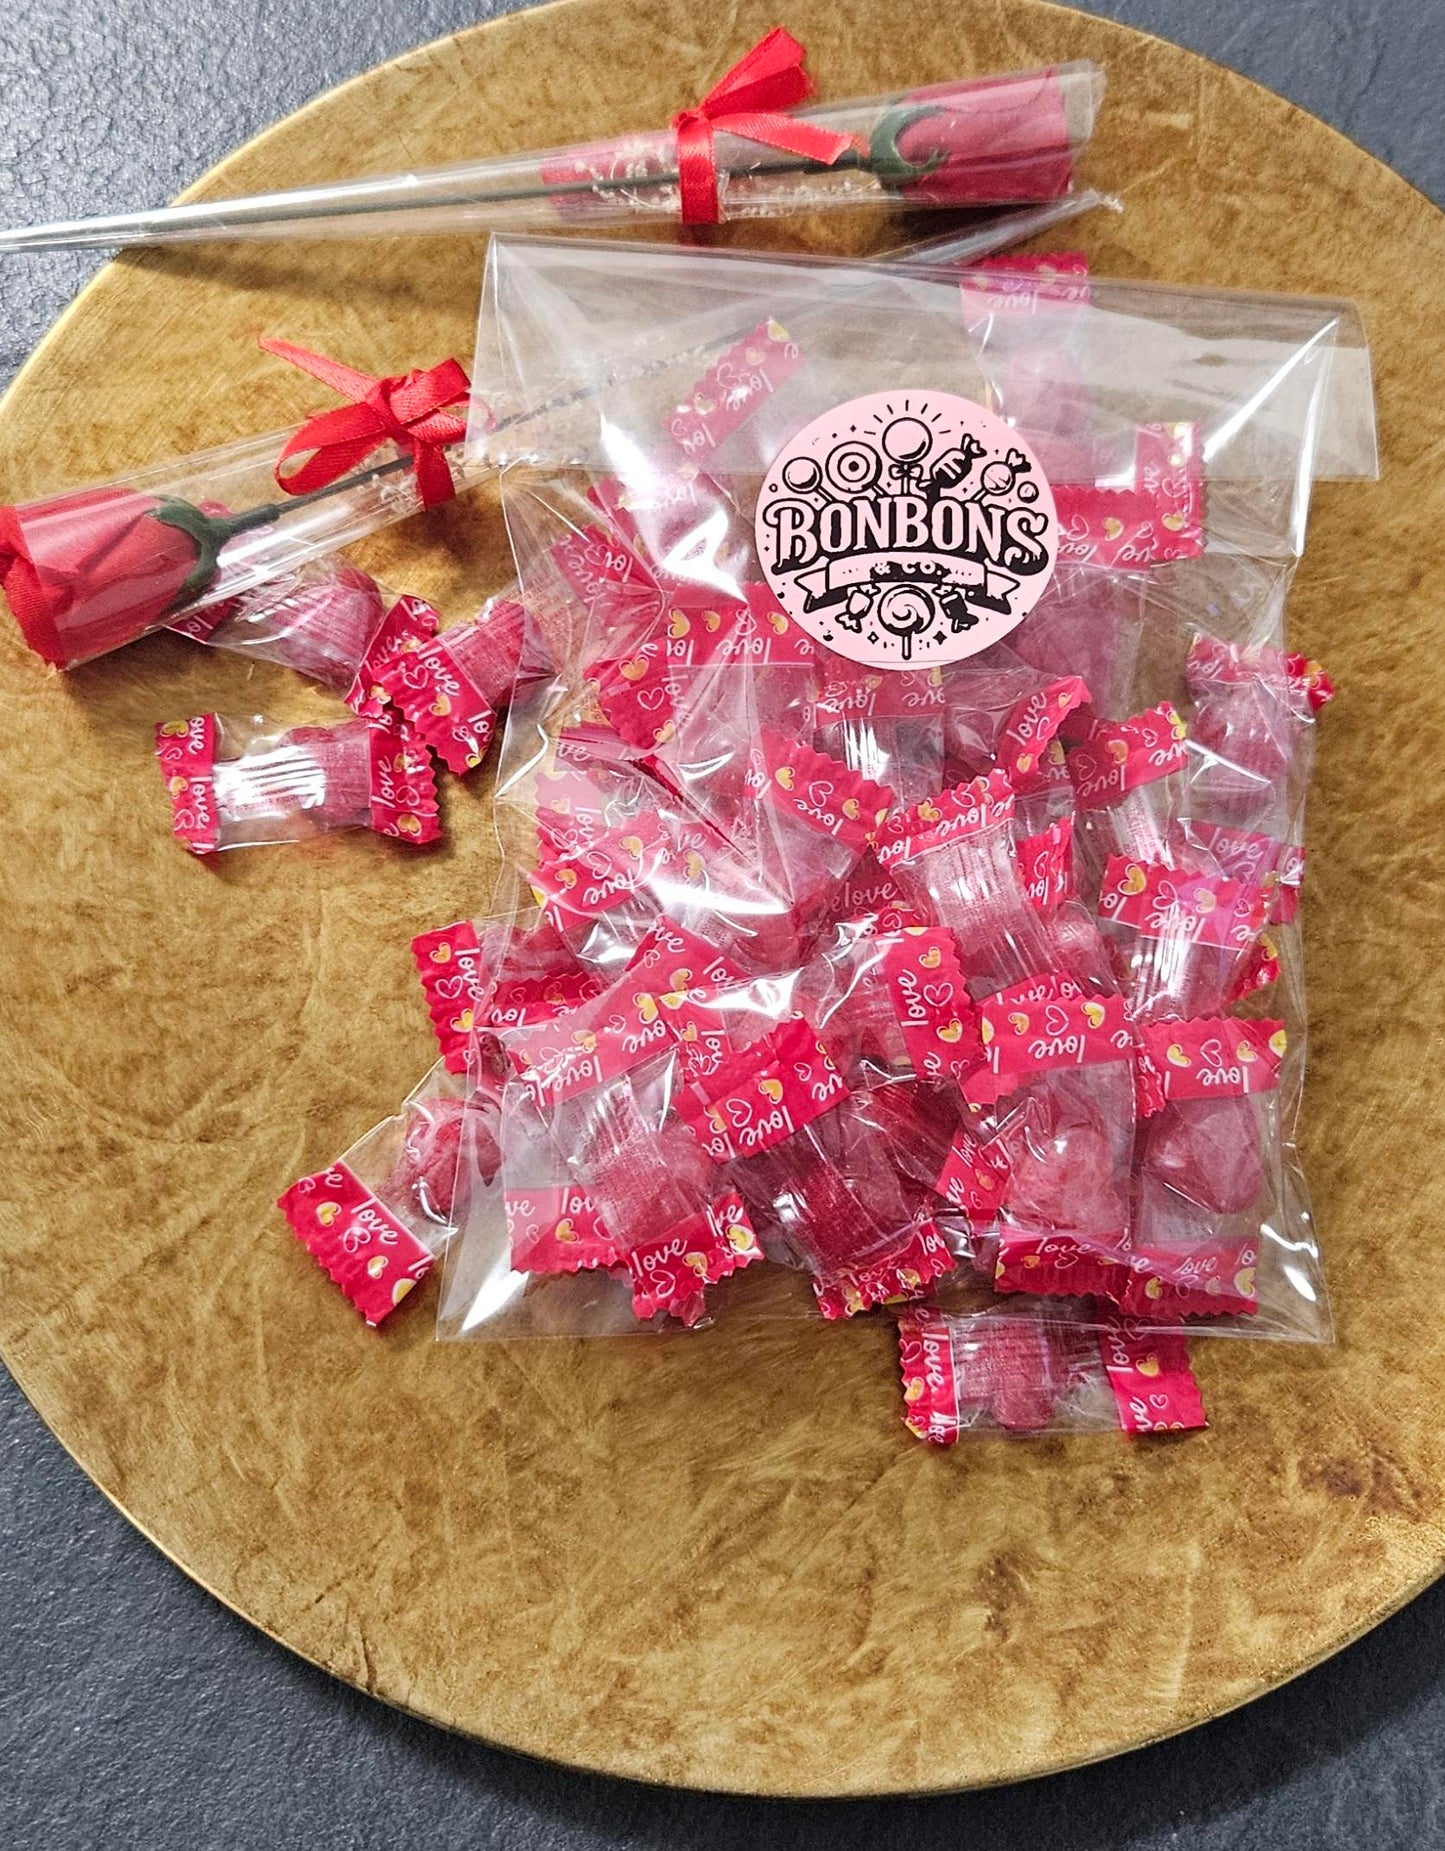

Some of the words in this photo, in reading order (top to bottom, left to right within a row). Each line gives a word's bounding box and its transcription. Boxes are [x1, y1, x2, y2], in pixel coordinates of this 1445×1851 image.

[763, 494, 1049, 576] BONBONS
[417, 645, 460, 697] love
[716, 638, 771, 665] love
[1006, 692, 1047, 747] love
[371, 756, 396, 809] love
[1076, 765, 1126, 797] love
[189, 775, 210, 829] love
[793, 798, 843, 836] love
[935, 803, 986, 837] love
[844, 882, 898, 908] love
[454, 948, 485, 1002] love
[898, 969, 930, 1027] love
[622, 1020, 682, 1054] love
[1028, 1035, 1085, 1064] love
[555, 1055, 603, 1092] love
[1196, 1066, 1249, 1094] love
[739, 1105, 795, 1147] love
[951, 1132, 977, 1169] love
[350, 1198, 399, 1246] love
[631, 1238, 688, 1278] love
[1036, 1236, 1096, 1255] love
[1172, 1256, 1217, 1276] love
[922, 1332, 949, 1388] love
[1106, 1316, 1134, 1373] love
